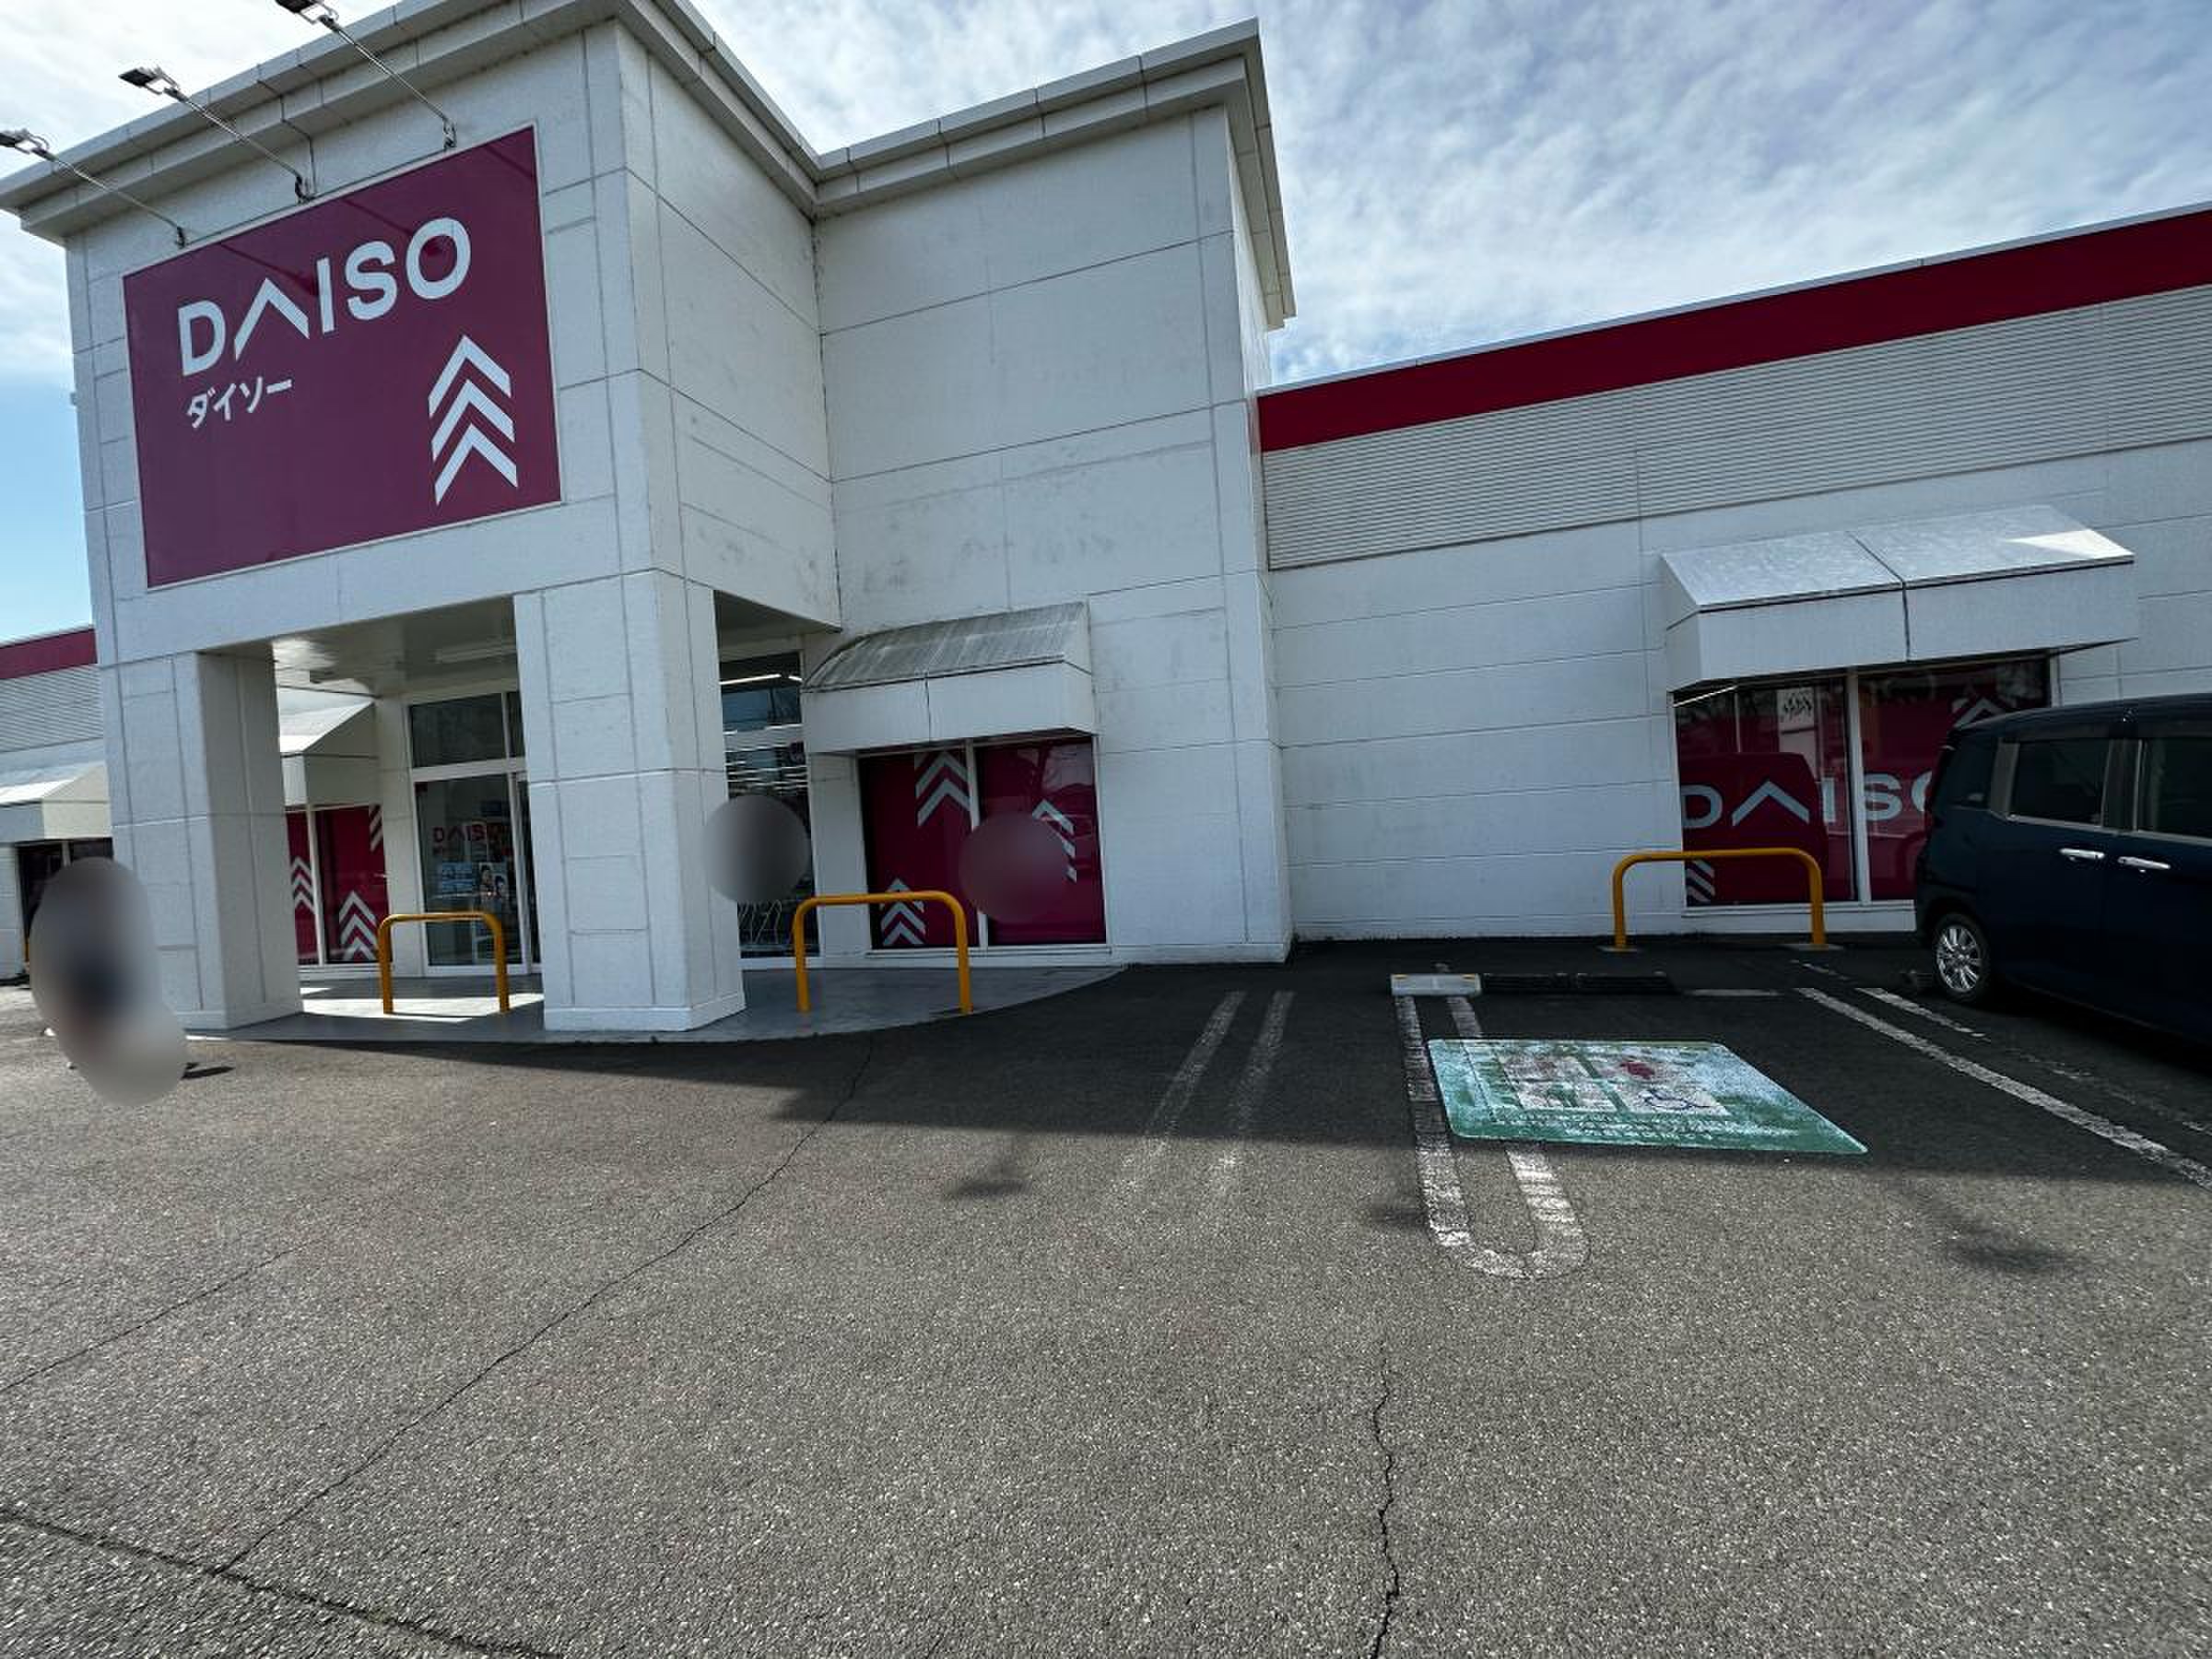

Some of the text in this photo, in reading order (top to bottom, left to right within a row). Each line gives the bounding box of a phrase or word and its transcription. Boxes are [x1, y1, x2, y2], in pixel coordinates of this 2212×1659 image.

[178, 218, 471, 377] DAISO
[187, 376, 293, 429] ダイソー
